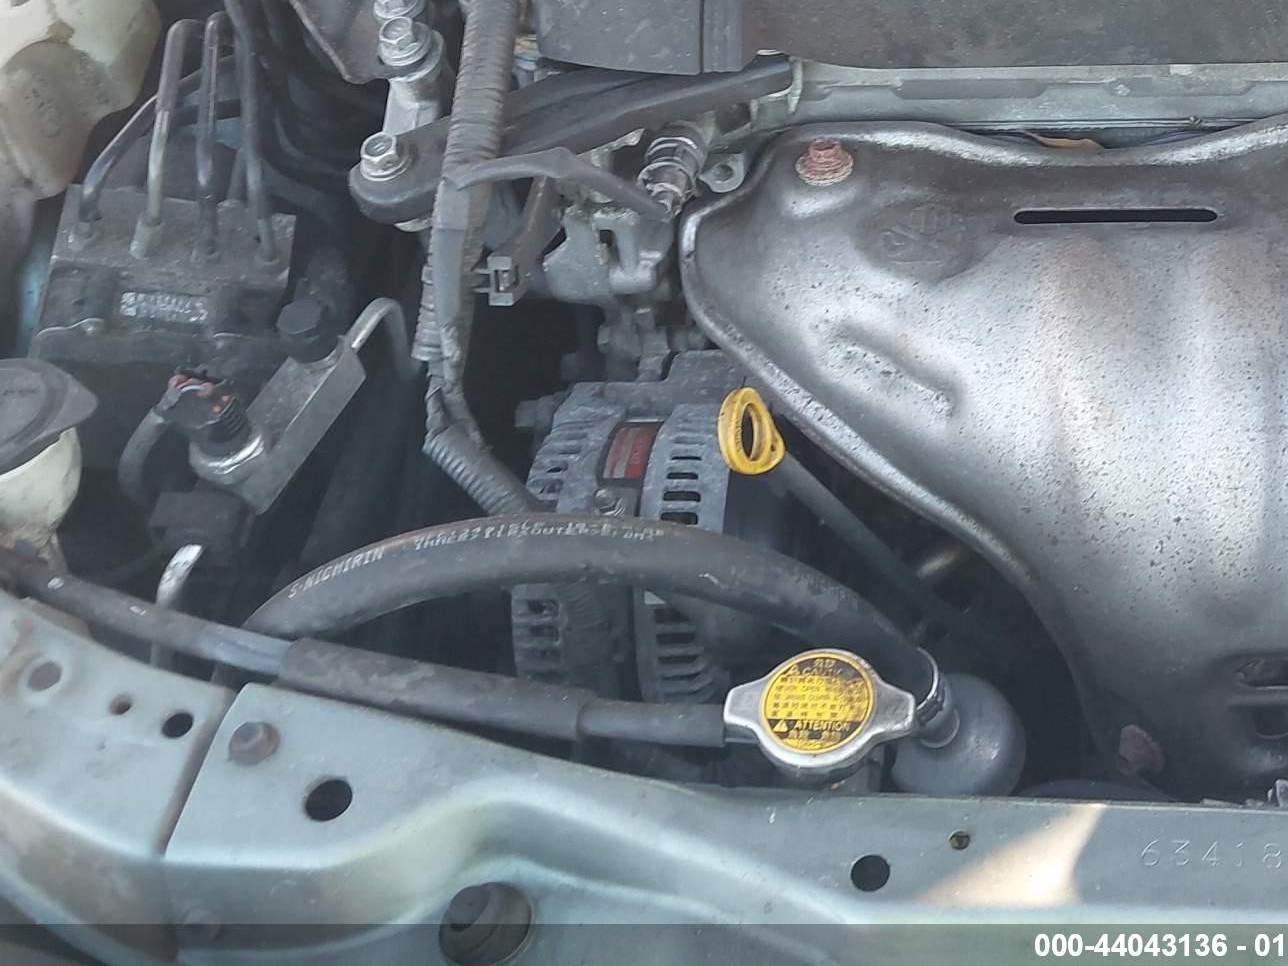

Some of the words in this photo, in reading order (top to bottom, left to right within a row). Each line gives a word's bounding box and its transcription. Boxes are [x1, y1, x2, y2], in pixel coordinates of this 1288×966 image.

[287, 546, 385, 599] S-NICHIRIN
[793, 720, 850, 732] ATTENTION
[1140, 839, 1282, 868] 63418
